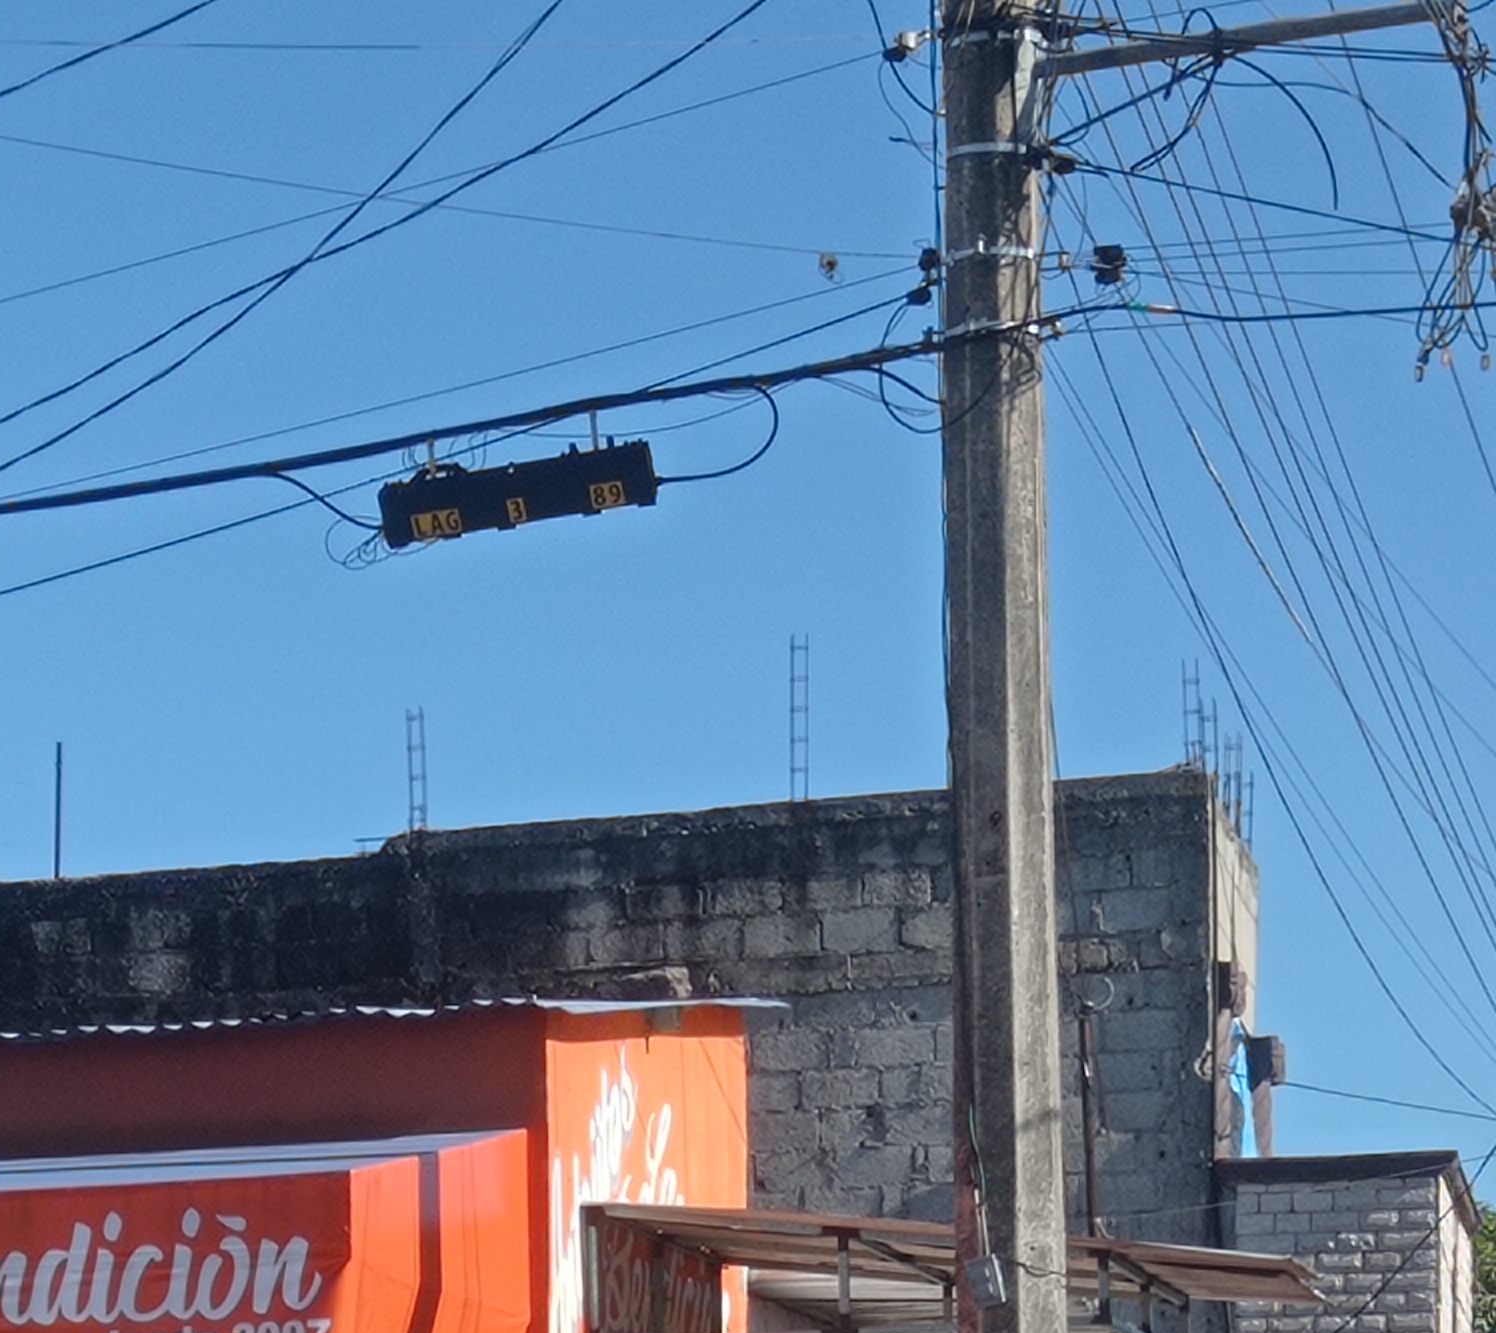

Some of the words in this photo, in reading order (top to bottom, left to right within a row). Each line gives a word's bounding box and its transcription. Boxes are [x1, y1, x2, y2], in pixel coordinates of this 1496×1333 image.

[413, 510, 460, 537] LAG
[509, 500, 524, 521] 3
[592, 482, 623, 507] 89
